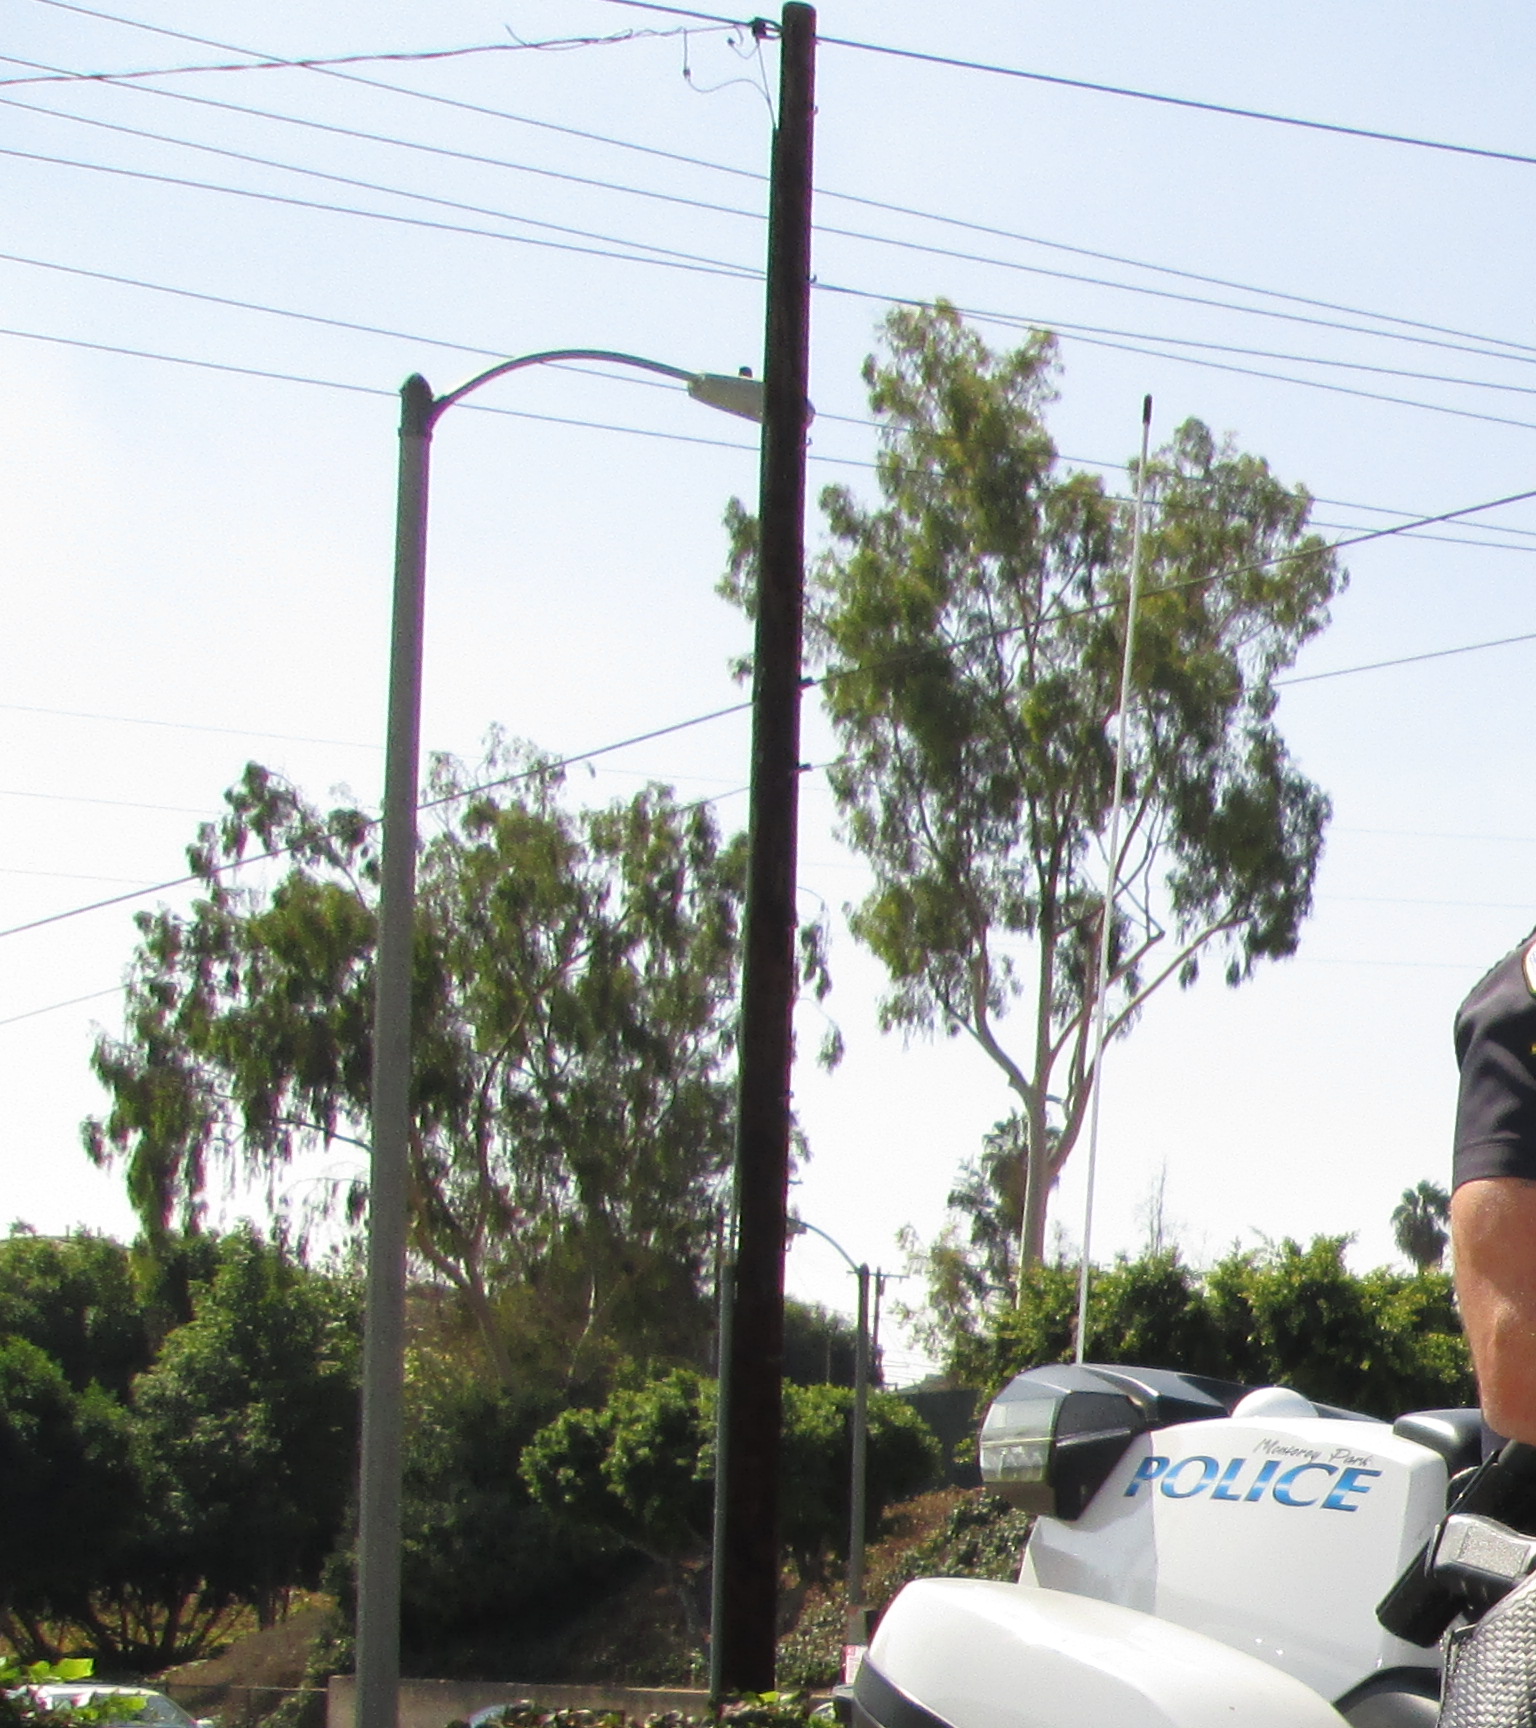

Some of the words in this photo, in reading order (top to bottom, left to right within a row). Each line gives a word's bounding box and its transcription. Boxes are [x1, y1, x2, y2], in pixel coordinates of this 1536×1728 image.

[1253, 1438, 1322, 1463] Monterey
[1329, 1448, 1373, 1467] Park
[1124, 1455, 1382, 1512] POLICE
